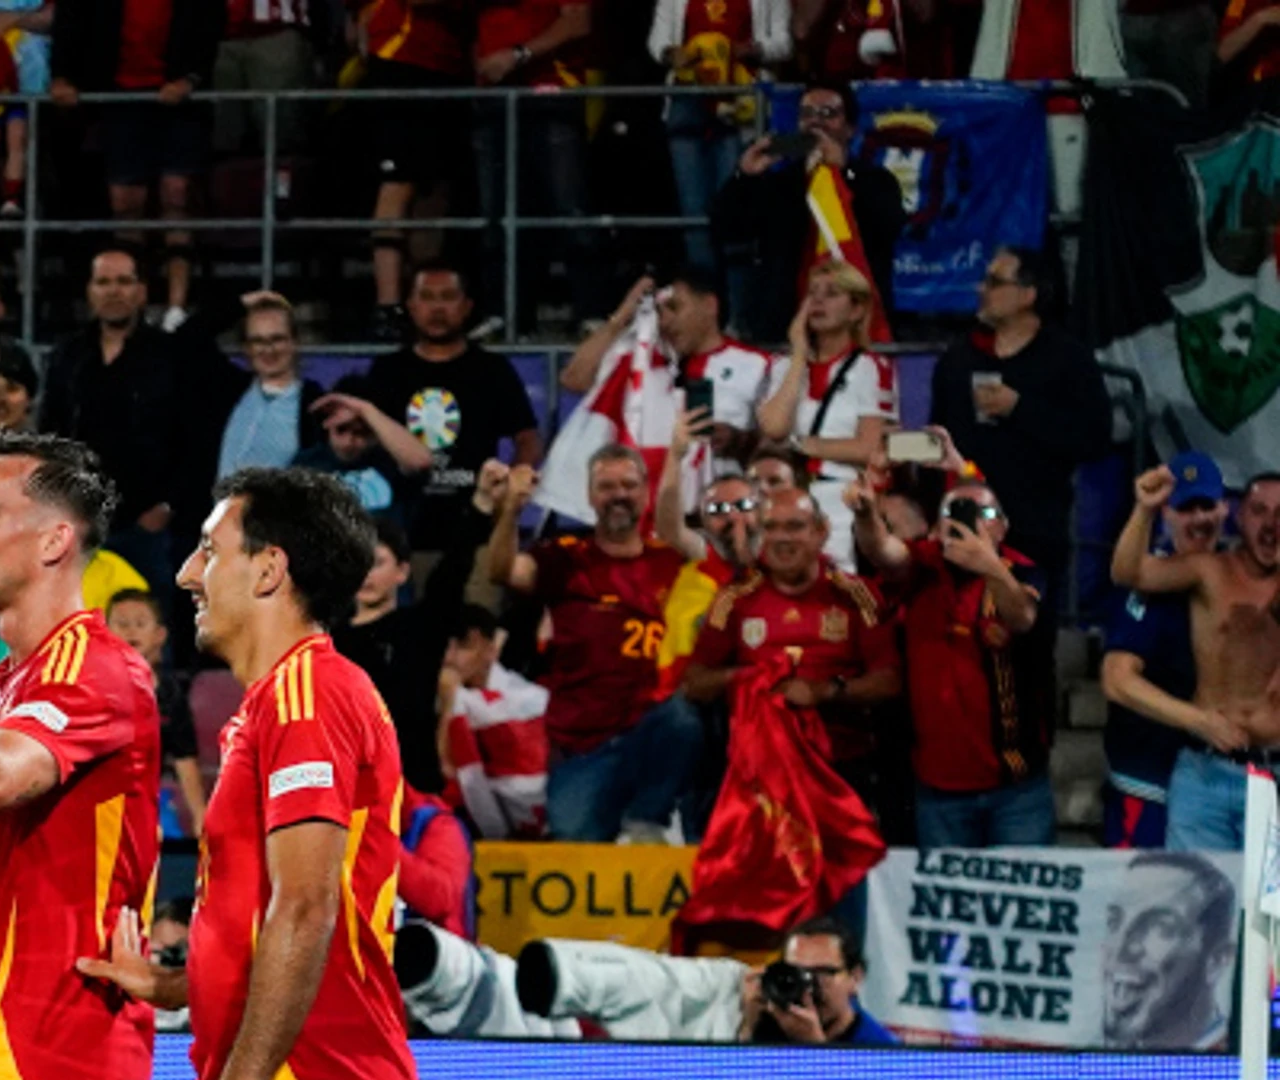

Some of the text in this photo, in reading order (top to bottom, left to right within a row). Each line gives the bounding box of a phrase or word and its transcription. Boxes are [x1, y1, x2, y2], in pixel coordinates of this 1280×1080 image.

[621, 618, 666, 659] 26
[915, 848, 1085, 892] LEGENDS
[909, 883, 1080, 935] NEVER
[906, 926, 1075, 979] WALK
[899, 971, 1073, 1024] ALONE
